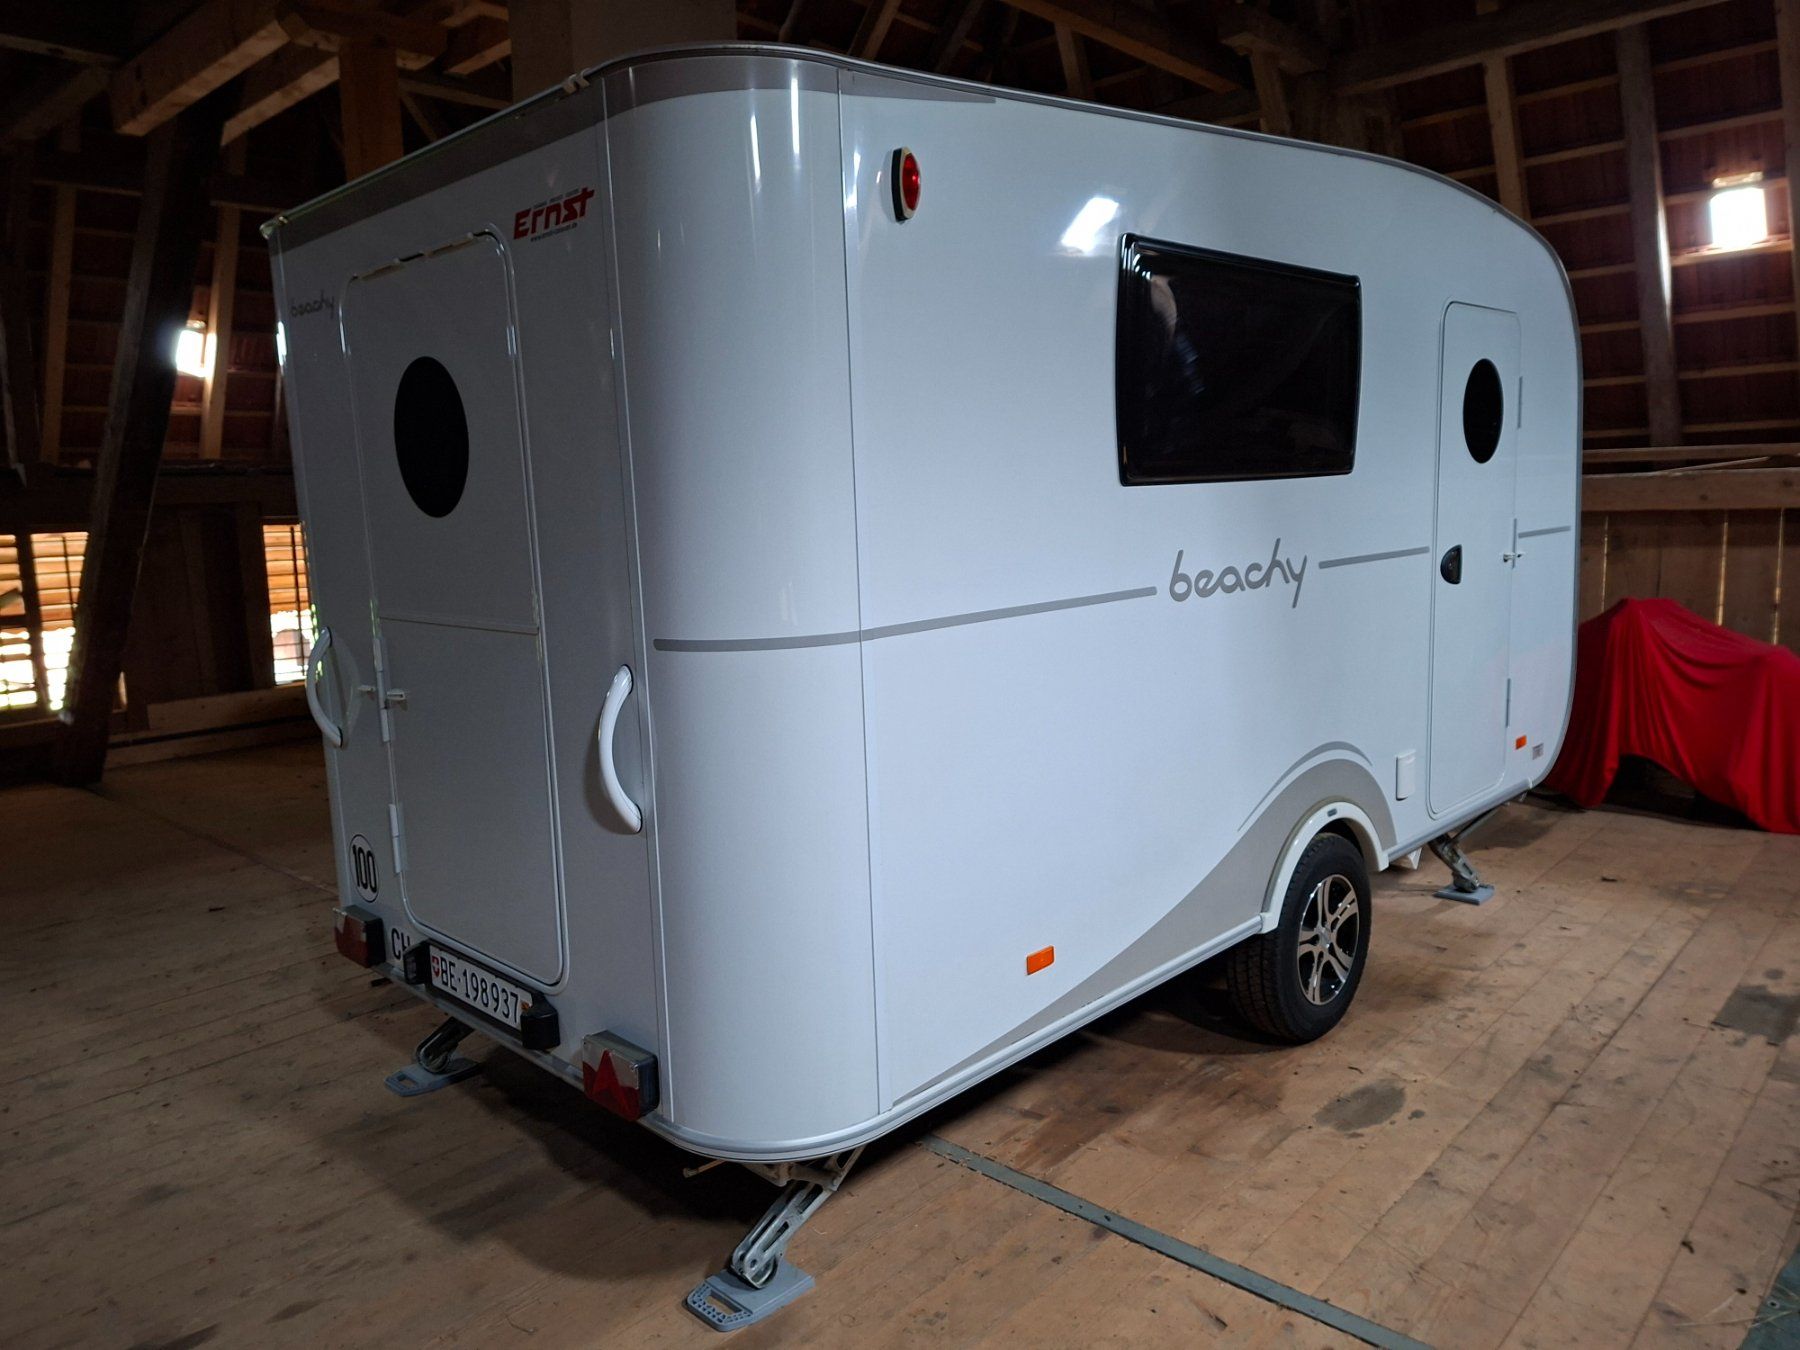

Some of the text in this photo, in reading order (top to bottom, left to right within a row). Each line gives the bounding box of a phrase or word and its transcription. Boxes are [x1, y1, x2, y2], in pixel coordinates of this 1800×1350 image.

[513, 187, 595, 240] Ernst
[1169, 537, 1307, 609] beachy
[352, 844, 378, 894] 100
